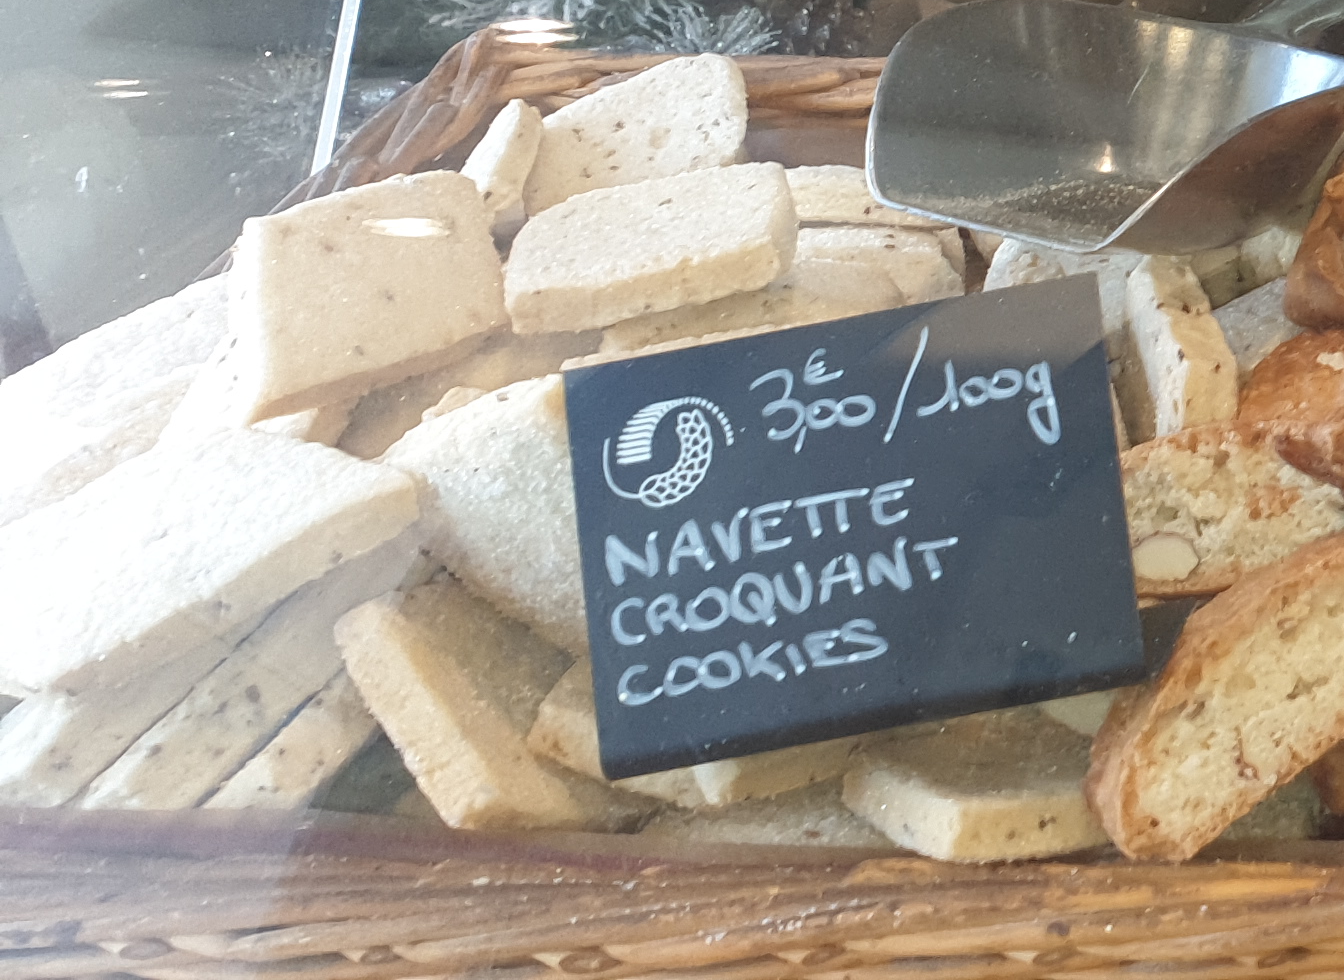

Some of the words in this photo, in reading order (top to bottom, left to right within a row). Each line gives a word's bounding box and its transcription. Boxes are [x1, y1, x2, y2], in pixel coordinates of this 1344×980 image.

[604, 477, 916, 586] NAVETTE
[611, 536, 958, 646] CROQUANT
[616, 618, 890, 708] COOKIES
